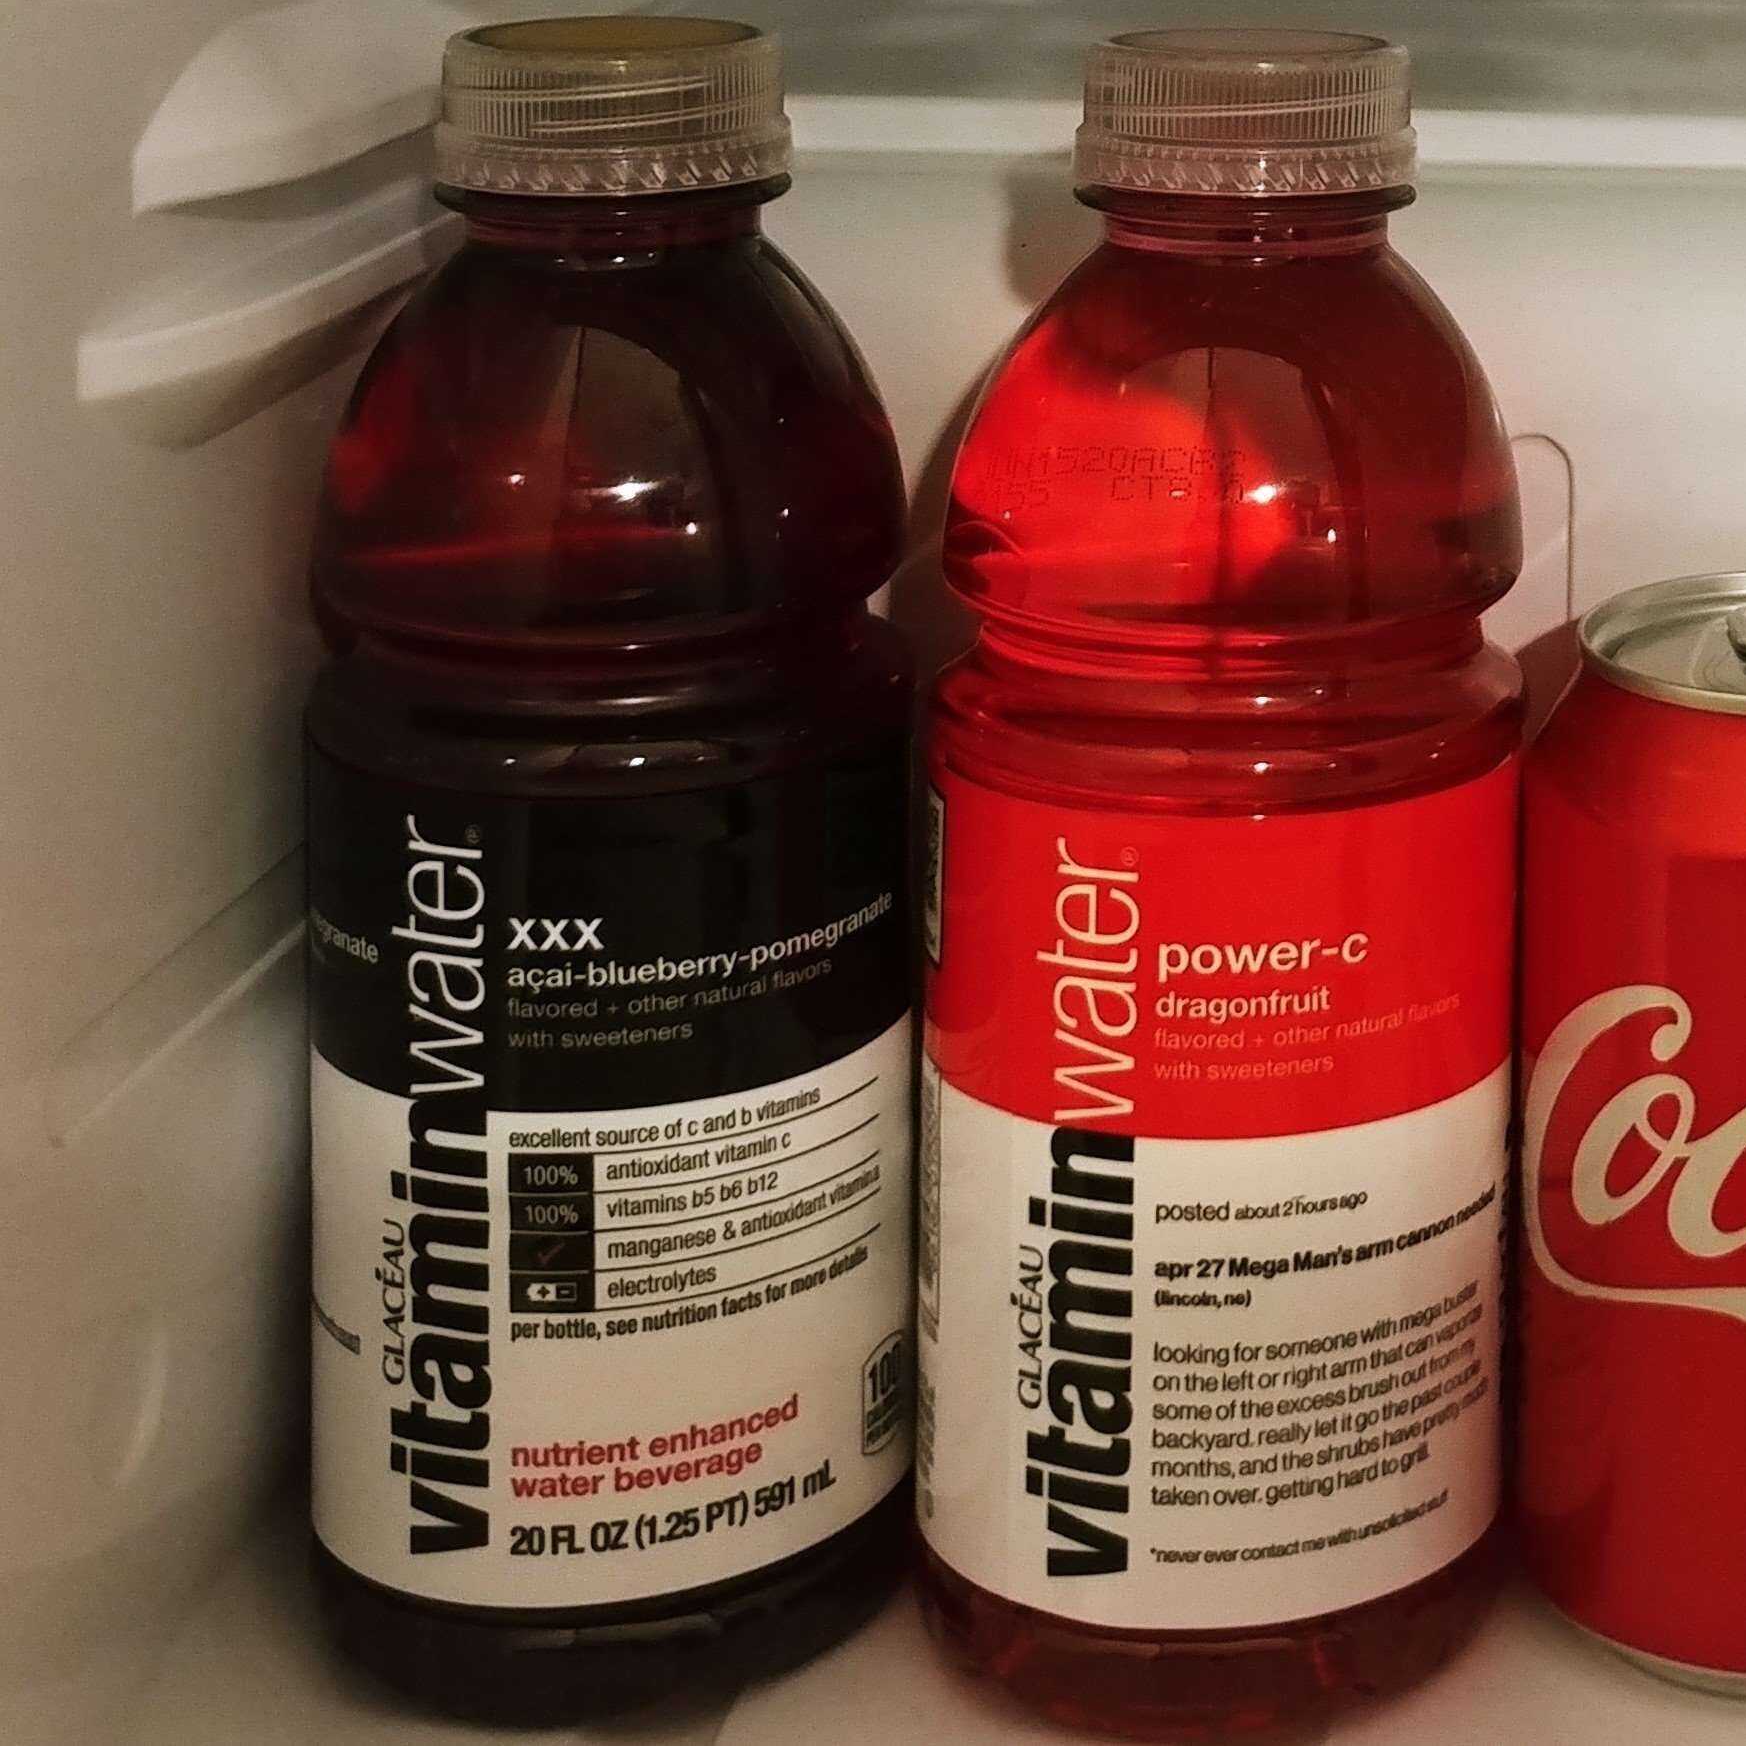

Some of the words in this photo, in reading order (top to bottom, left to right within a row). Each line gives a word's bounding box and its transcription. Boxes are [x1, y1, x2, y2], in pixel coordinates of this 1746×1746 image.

[507, 917, 604, 952] xxx
[1158, 933, 1369, 982] power-c
[1156, 986, 1330, 1026] dragonfruit
[509, 1129, 591, 1149] excellent
[596, 1126, 659, 1145] source
[664, 1120, 682, 1139] of
[703, 1110, 736, 1134] and
[756, 1086, 821, 1122] vitamins
[524, 1166, 578, 1185] 100%
[606, 1152, 710, 1180] antioxidant
[714, 1135, 778, 1164] vitamin
[524, 1205, 578, 1223] 100%
[607, 1195, 687, 1218] vitamins
[692, 1187, 716, 1206] b5
[719, 1180, 743, 1201] b6
[748, 1172, 778, 1196] b12
[1155, 1201, 1230, 1224] posted
[608, 1265, 717, 1298] electrolytes
[1155, 1260, 1193, 1281] apr
[1196, 1258, 1224, 1279] 27
[1228, 1256, 1289, 1280] Mega
[1293, 1245, 1353, 1273] Man's
[511, 1435, 641, 1467] nutrient
[648, 1394, 800, 1455] enhanced
[511, 1472, 601, 1499] water
[614, 1440, 764, 1493] beverage
[511, 1526, 545, 1555] 20
[551, 1525, 584, 1554] FL
[590, 1521, 629, 1551] OZ
[636, 1508, 700, 1550] (1.25
[706, 1492, 749, 1535] PT)
[754, 1476, 794, 1519] 591
[802, 1460, 836, 1497] mL
